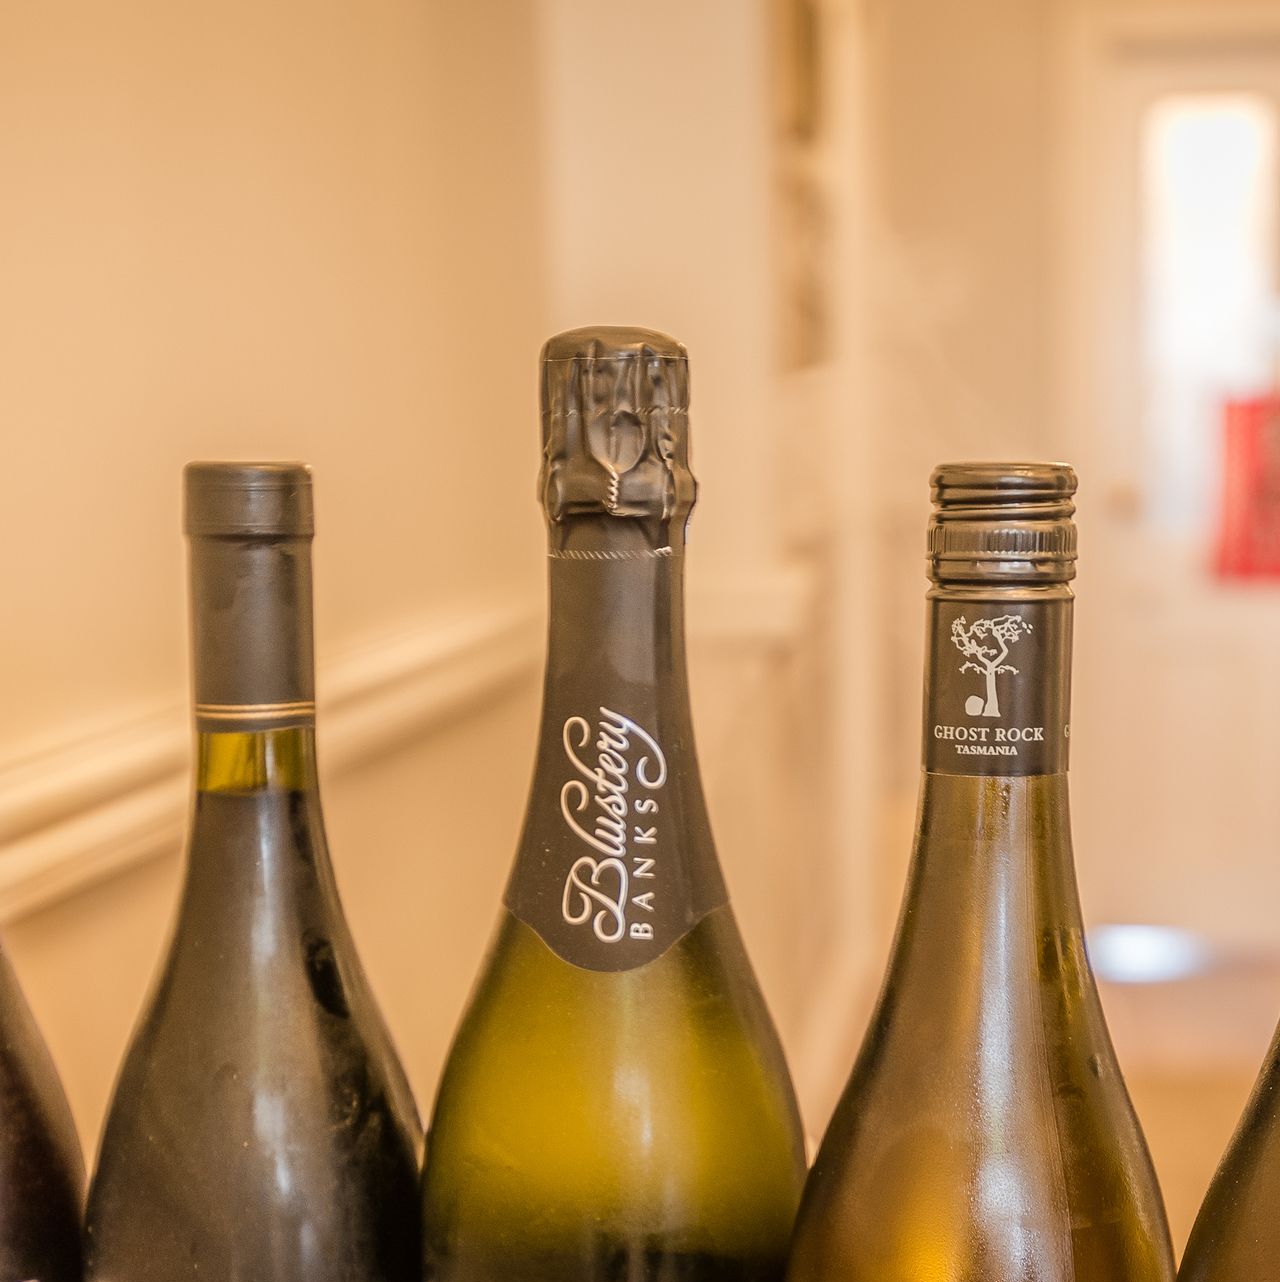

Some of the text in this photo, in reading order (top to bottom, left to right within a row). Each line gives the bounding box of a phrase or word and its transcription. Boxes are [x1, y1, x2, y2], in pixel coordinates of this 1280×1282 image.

[933, 724, 990, 742] GHOST
[994, 726, 1045, 742] ROCK
[954, 744, 1018, 756] TASMANIA
[560, 706, 667, 944] Blustery
[629, 798, 660, 940] BANKS
